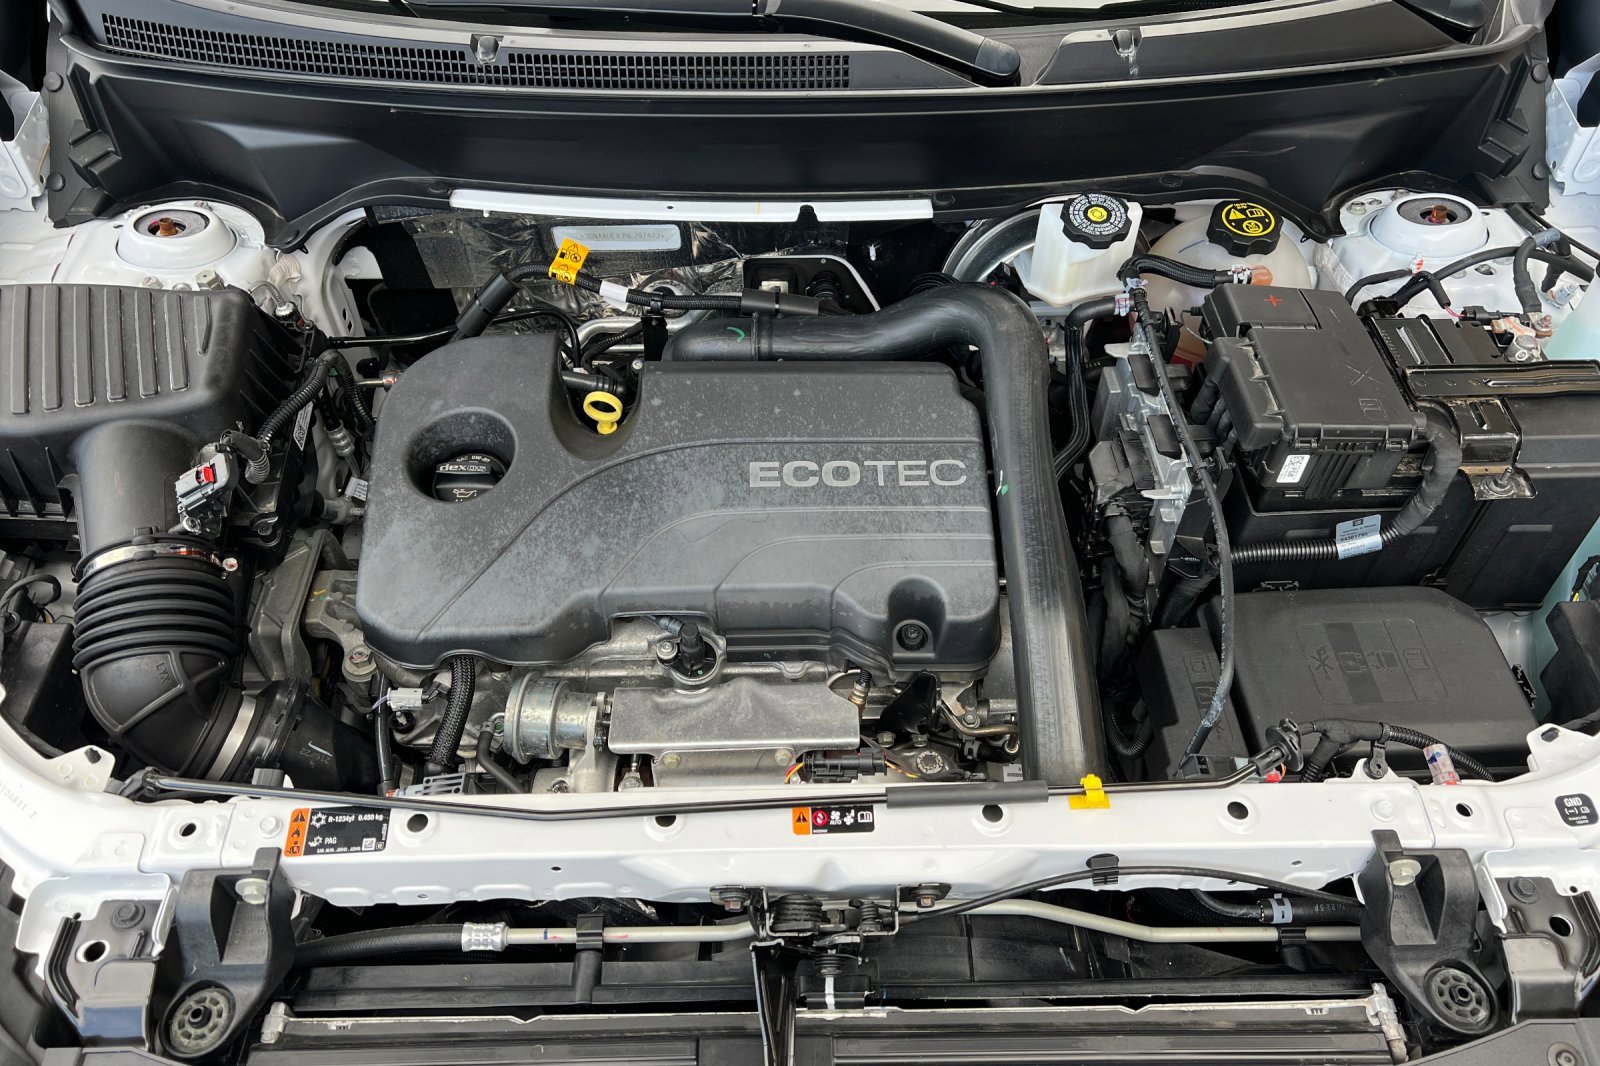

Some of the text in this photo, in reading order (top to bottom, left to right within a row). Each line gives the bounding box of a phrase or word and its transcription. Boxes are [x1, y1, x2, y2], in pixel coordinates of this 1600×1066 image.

[749, 459, 967, 488] ECOTEC
[1563, 797, 1583, 807] GND
[374, 813, 384, 822] kg
[324, 836, 338, 845] PAG
